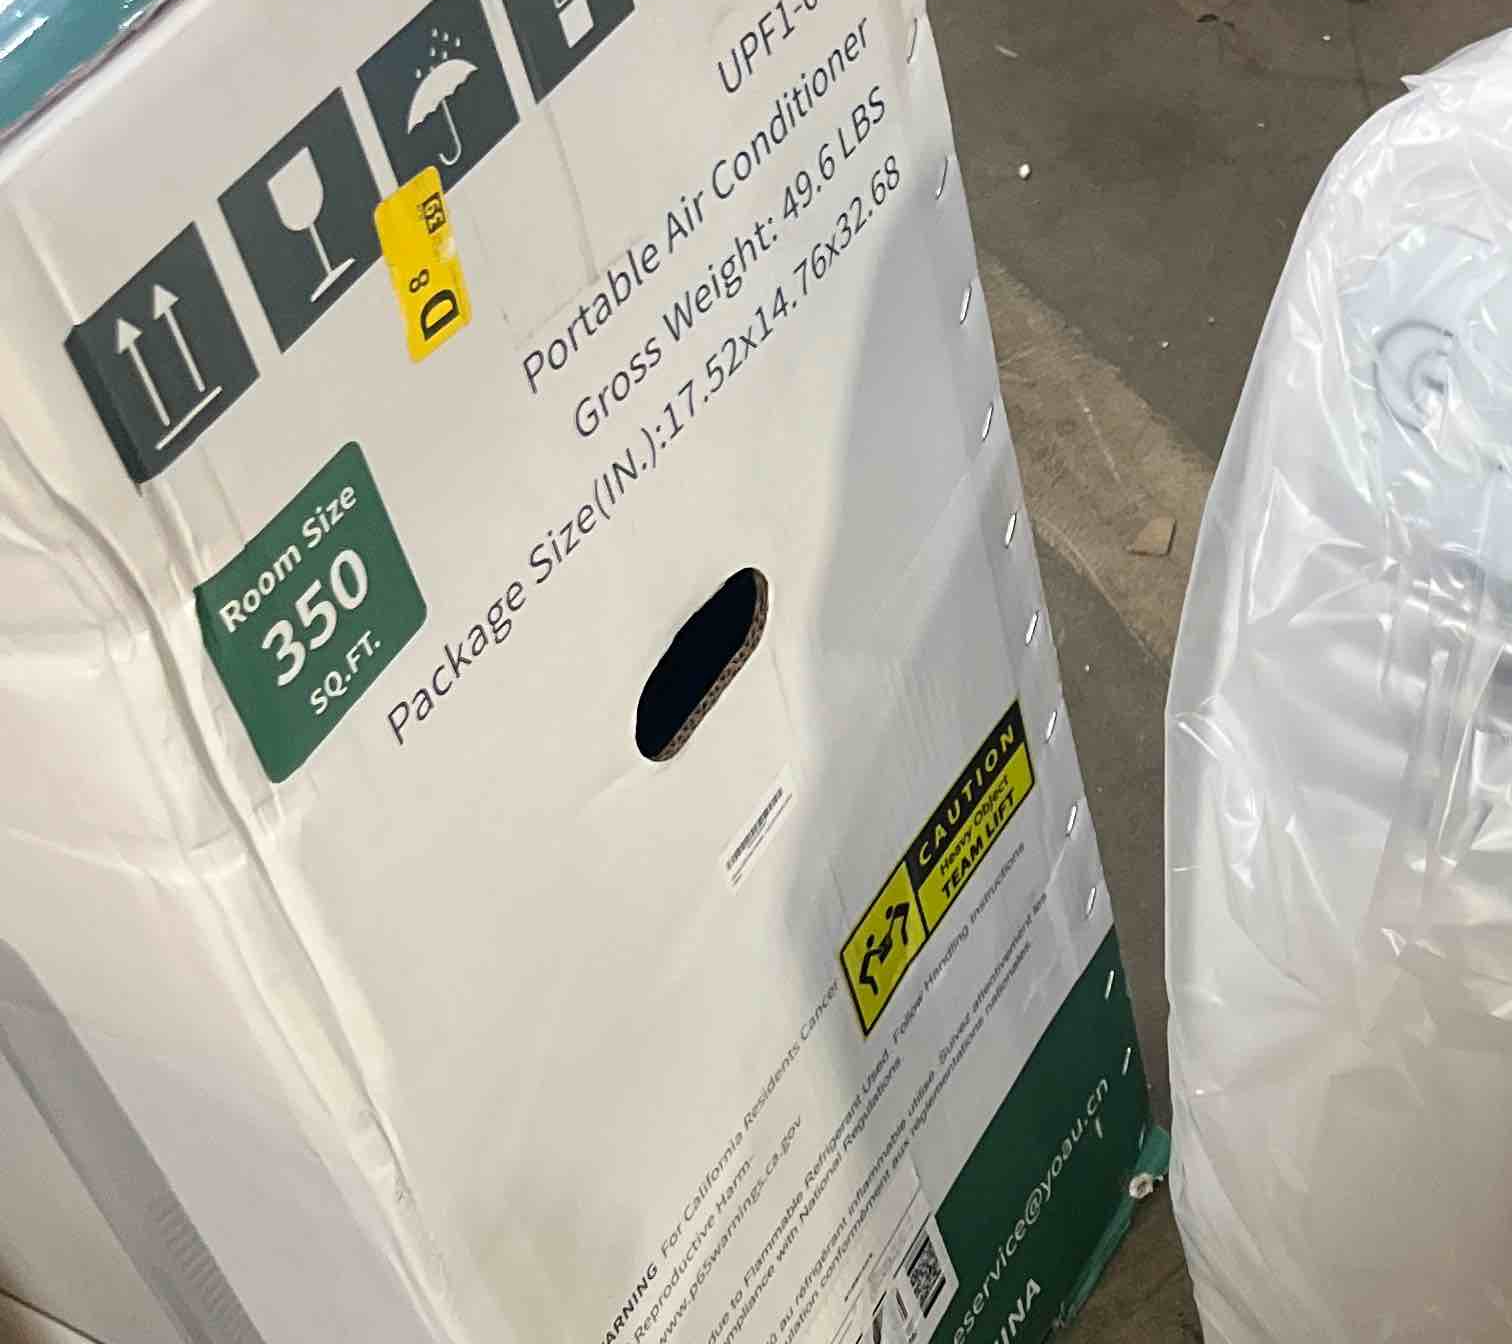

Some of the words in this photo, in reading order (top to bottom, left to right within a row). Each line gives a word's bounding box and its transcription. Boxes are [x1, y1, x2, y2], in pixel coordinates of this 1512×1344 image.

[521, 241, 662, 394] Portable
[667, 189, 705, 253] Air
[711, 17, 869, 200] Conditioner
[574, 336, 663, 439] Gross
[662, 215, 778, 343] Weight:
[782, 143, 837, 221] 49.6
[836, 85, 887, 160] LBS
[409, 268, 430, 294] 8
[420, 289, 460, 341] D
[386, 580, 528, 746] Package
[528, 155, 901, 585] Size(IN.):17.52x14.76x32.68
[219, 544, 302, 633] Room
[302, 486, 357, 548] Size
[262, 549, 368, 687] 350
[310, 630, 381, 714] SQ.FT.
[919, 723, 1015, 866] CAUTION
[939, 827, 973, 876] Heavy
[973, 774, 1010, 827] Object
[941, 835, 984, 900] TEAM
[985, 786, 1016, 839] LIFT
[660, 1221, 684, 1260] For
[683, 1131, 744, 1222] California
[743, 1041, 801, 1132] Residents
[800, 978, 840, 1042] Cancer
[730, 1288, 744, 1309] to
[743, 1190, 804, 1288] Flammable
[804, 1094, 862, 1188] Refrigerant
[775, 1223, 800, 1262] with
[799, 1151, 842, 1225] National
[779, 1308, 795, 1334] au
